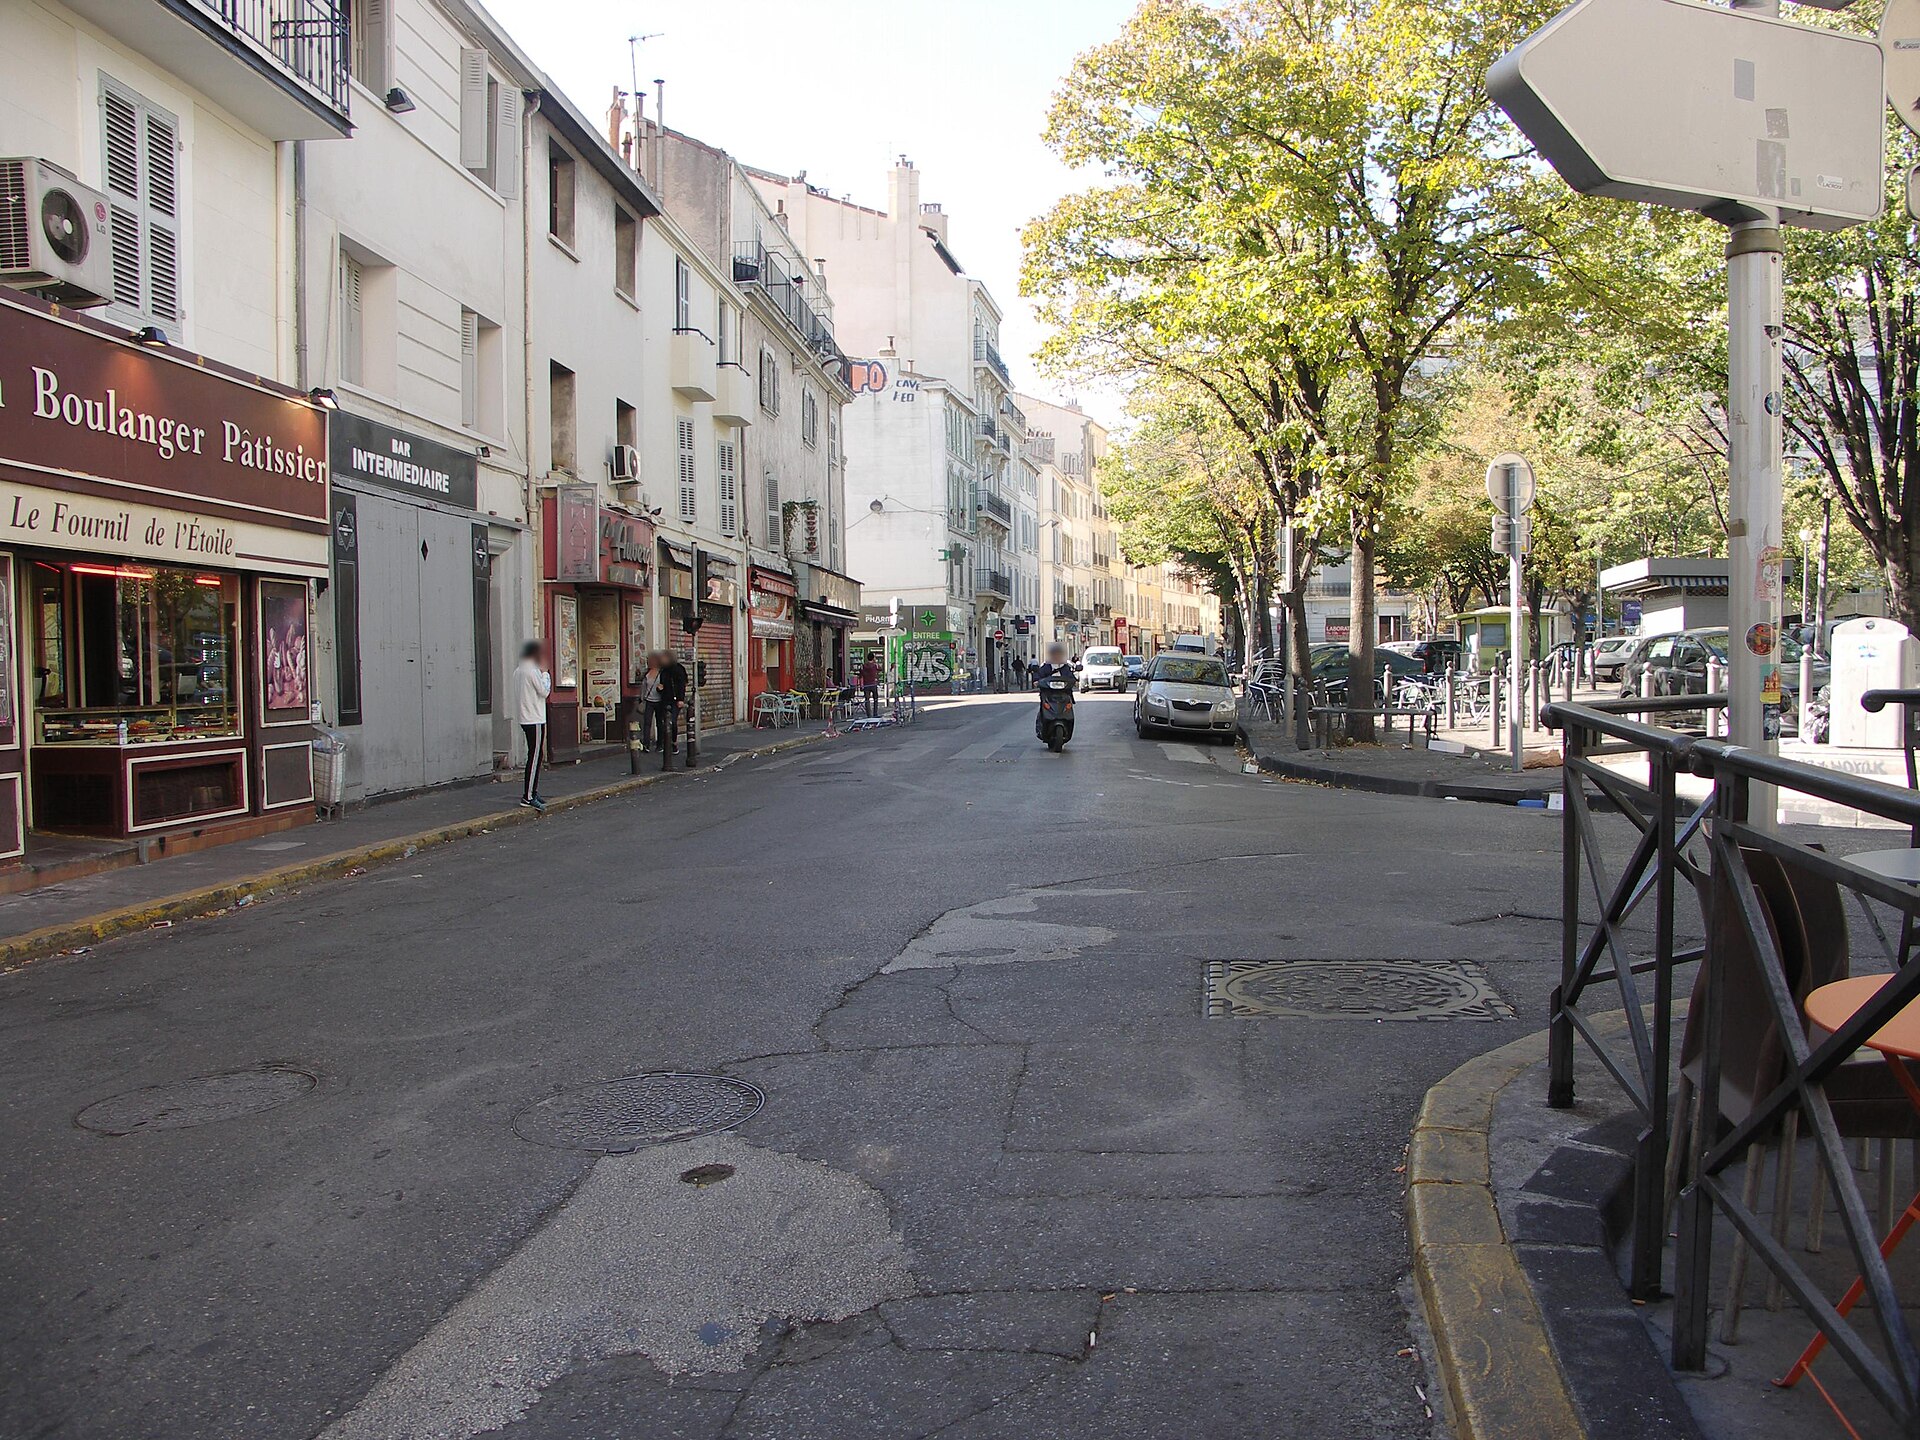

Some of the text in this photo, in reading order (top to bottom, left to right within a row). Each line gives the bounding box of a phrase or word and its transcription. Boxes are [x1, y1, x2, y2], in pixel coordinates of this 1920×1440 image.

[96, 223, 106, 235] LG
[31, 366, 326, 484] Boulanger Pâtissier
[391, 438, 411, 458] BAR
[352, 447, 450, 494] INTERMEDIAIRE
[10, 495, 233, 555] Le Fournil de l'Étoile
[913, 632, 940, 640] ENTREE
